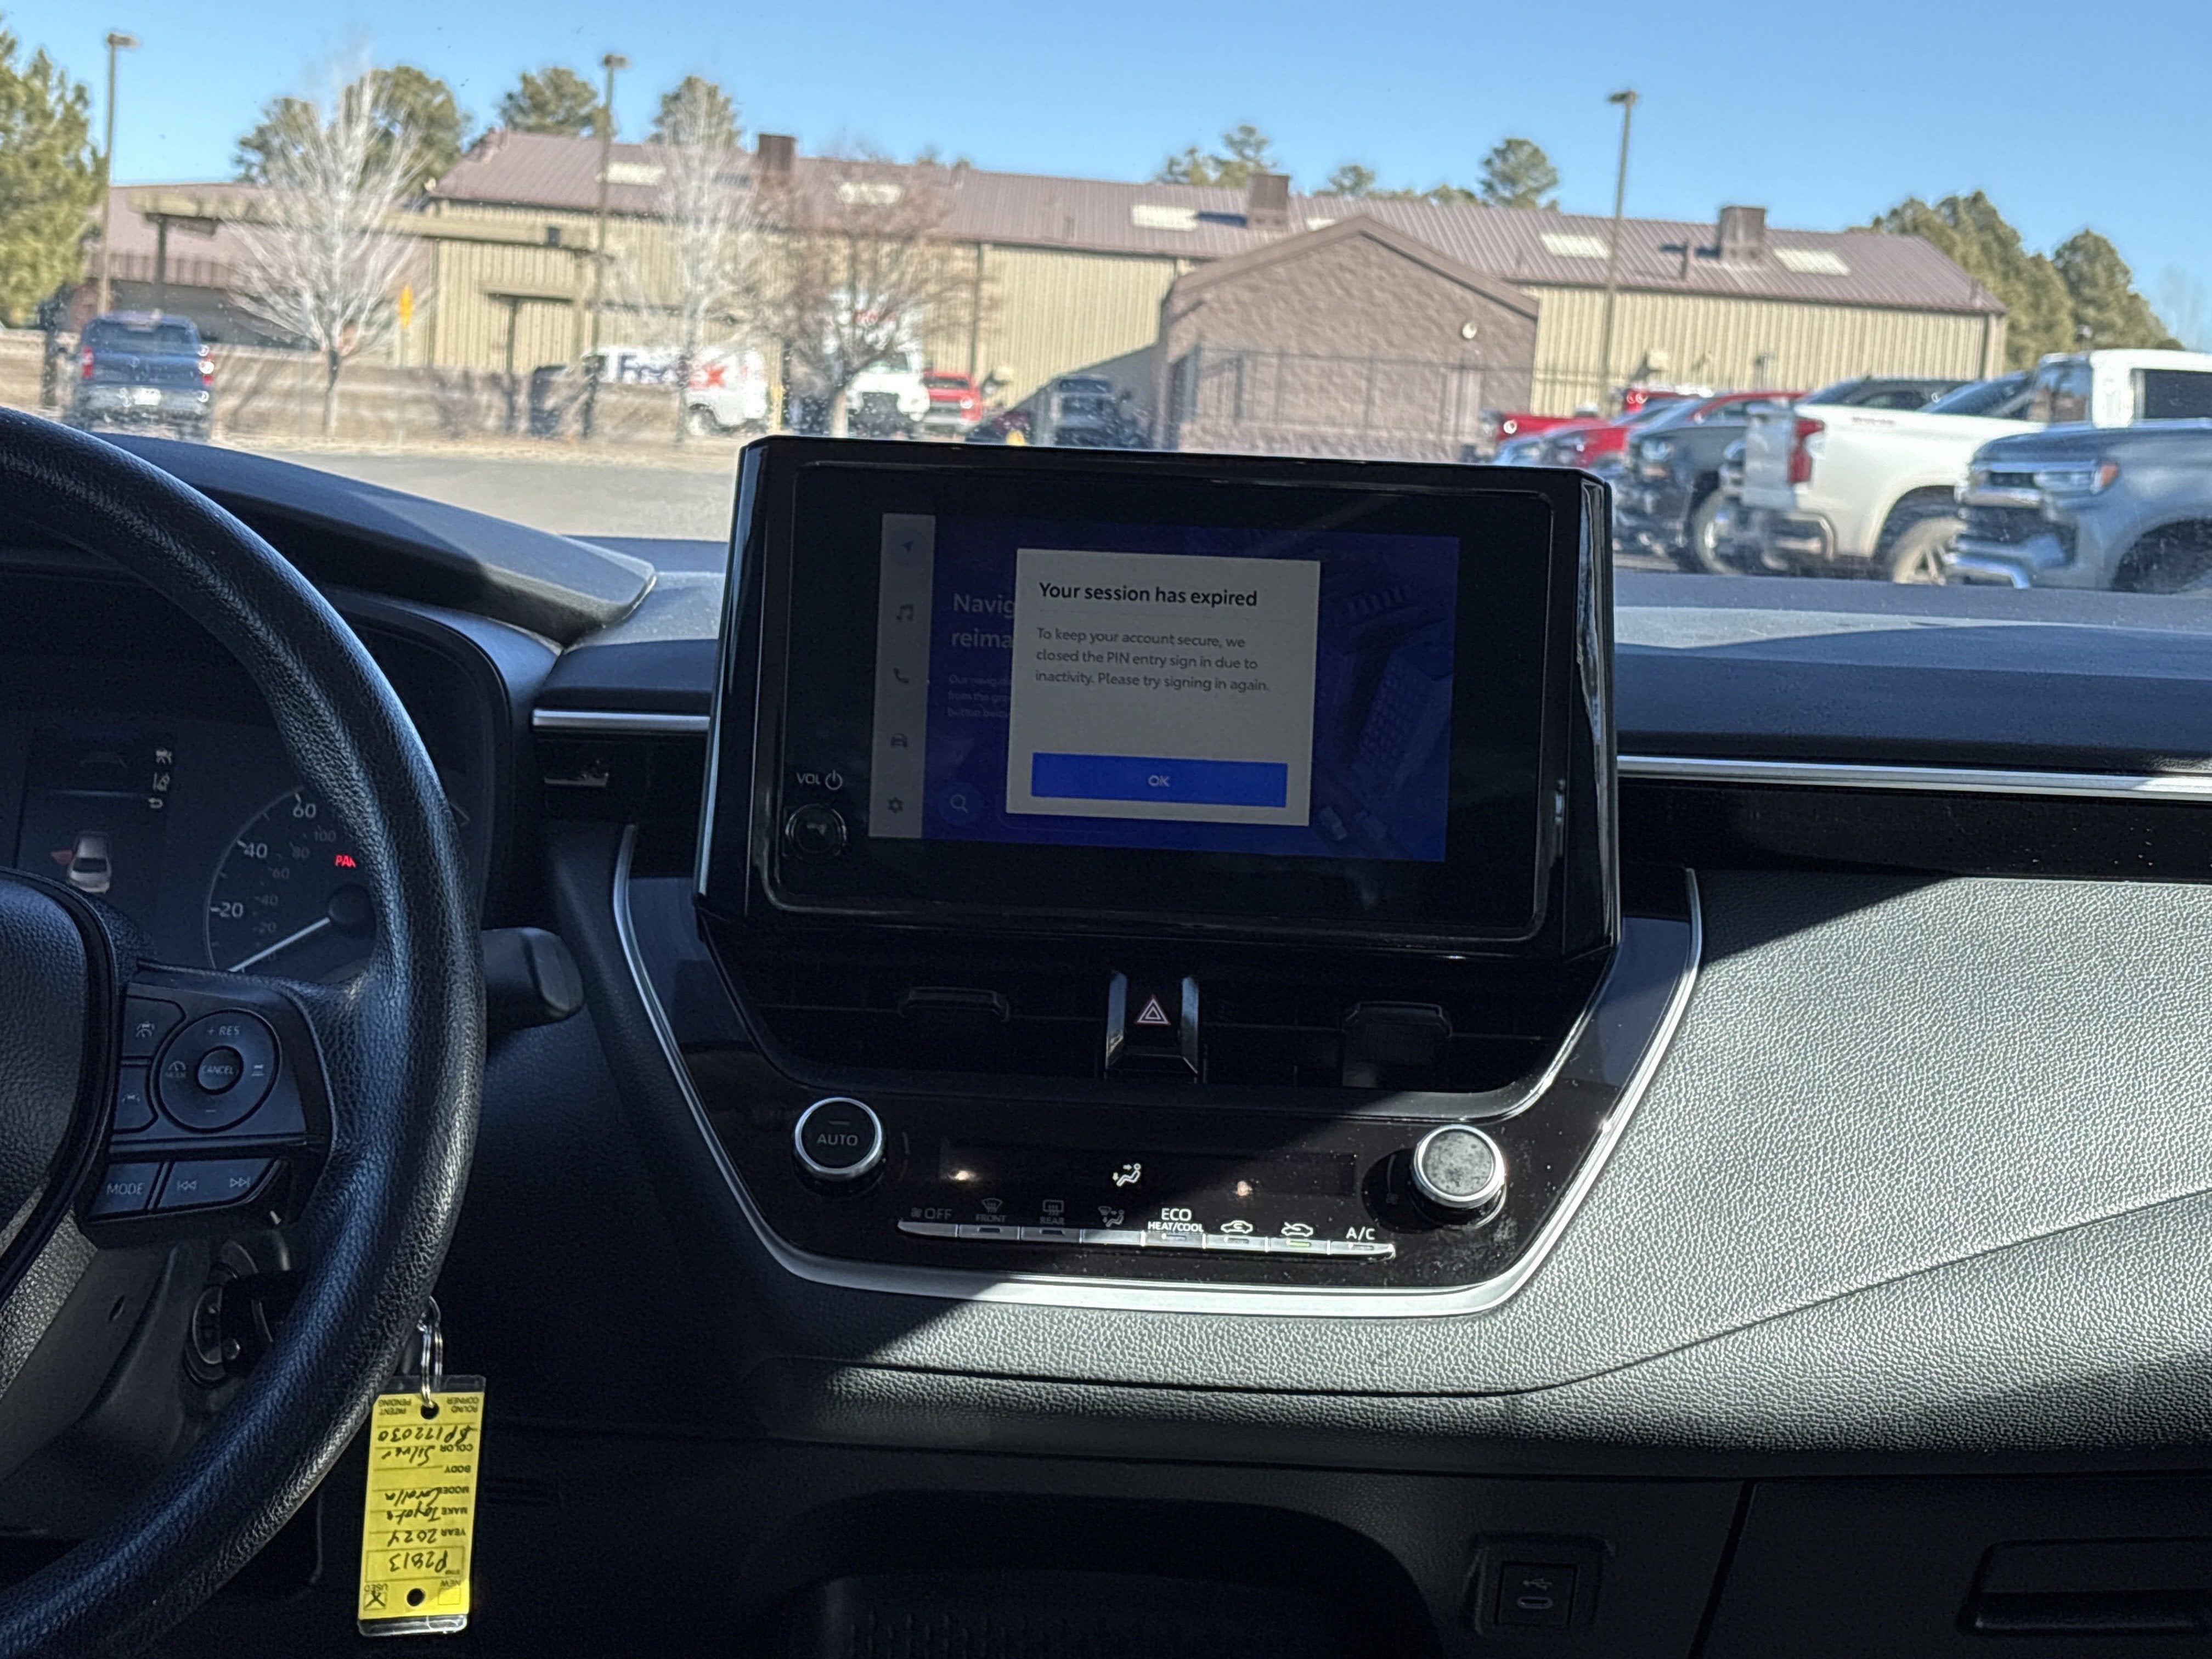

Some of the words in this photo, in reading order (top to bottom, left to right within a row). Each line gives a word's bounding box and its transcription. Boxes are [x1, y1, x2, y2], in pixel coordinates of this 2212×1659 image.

[1039, 582, 1080, 599] Your
[1085, 585, 1150, 602] session
[1156, 587, 1186, 604] has
[1191, 589, 1257, 608] expired
[1037, 627, 1052, 640] To
[1056, 628, 1086, 644] keep
[1088, 632, 1119, 645] your
[1122, 634, 1175, 646] account
[1178, 636, 1222, 648] secure,
[1226, 638, 1245, 647] we
[1036, 649, 1079, 662] closed
[1082, 651, 1103, 664] the
[1107, 652, 1129, 664] PIN
[1133, 655, 1166, 669] entry
[1170, 656, 1197, 670] sign
[1200, 656, 1211, 668] in
[1215, 657, 1241, 669] due
[1244, 658, 1257, 669] to
[1098, 672, 1139, 685] Please
[1143, 674, 1160, 689] try
[1164, 675, 1211, 691] signing
[1215, 678, 1227, 690] in
[1230, 679, 1269, 693] again.
[796, 772, 821, 785] VOL
[1148, 774, 1170, 787] OK
[292, 803, 317, 819] 60
[243, 842, 268, 859] 40
[219, 901, 244, 918] 20
[816, 1133, 859, 1146] AUTO
[106, 1182, 145, 1195] MODE
[925, 1207, 953, 1221] OFF
[975, 1213, 1008, 1223] FRONT
[1040, 1216, 1066, 1226] REAR
[1160, 1207, 1192, 1221] ECO
[1147, 1221, 1205, 1233] HEAT/COOL
[1346, 1226, 1376, 1241] A/C
[381, 1446, 435, 1466] Silver
[439, 1444, 473, 1453] COLOR
[386, 1502, 441, 1526] Toyota
[387, 1528, 437, 1547] 2024
[441, 1528, 466, 1536] YEAR
[389, 1550, 448, 1573] P2813
